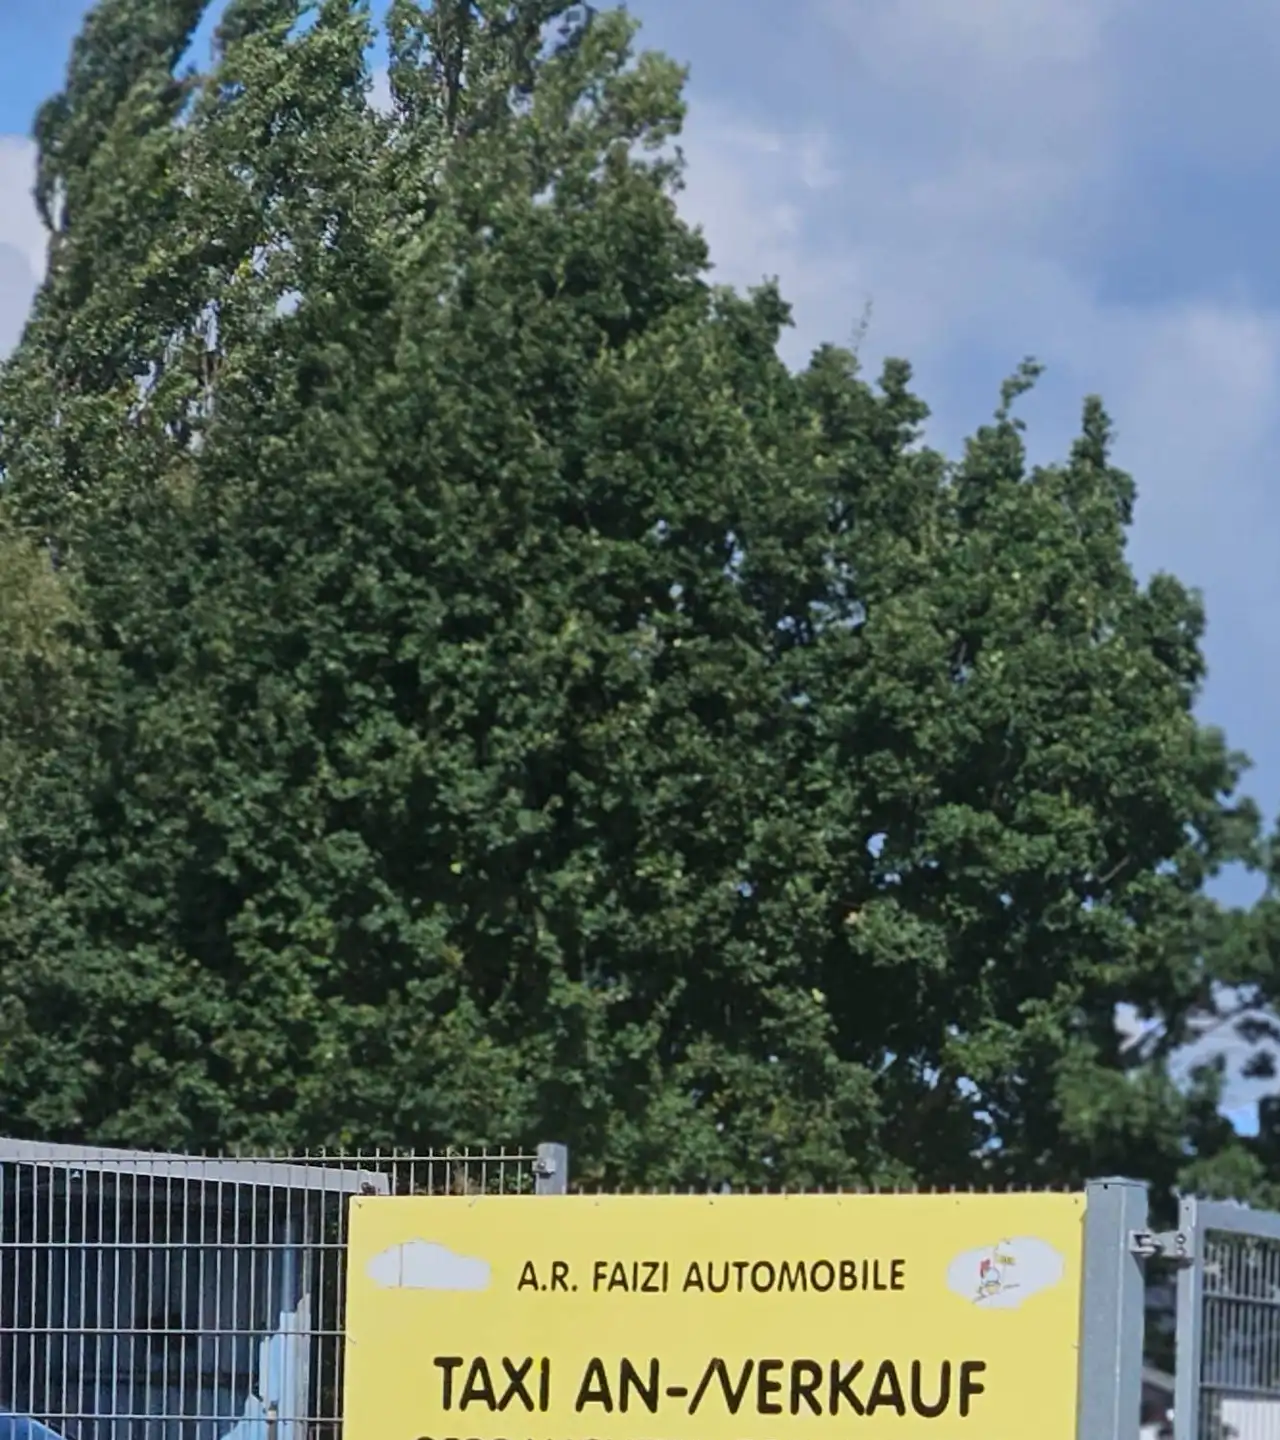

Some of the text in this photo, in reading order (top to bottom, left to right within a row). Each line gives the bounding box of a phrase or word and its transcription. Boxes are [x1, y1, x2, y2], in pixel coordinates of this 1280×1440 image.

[517, 1259, 905, 1292] A.R. FAIZI AUTOMOBILE
[433, 1356, 550, 1413] TAXI
